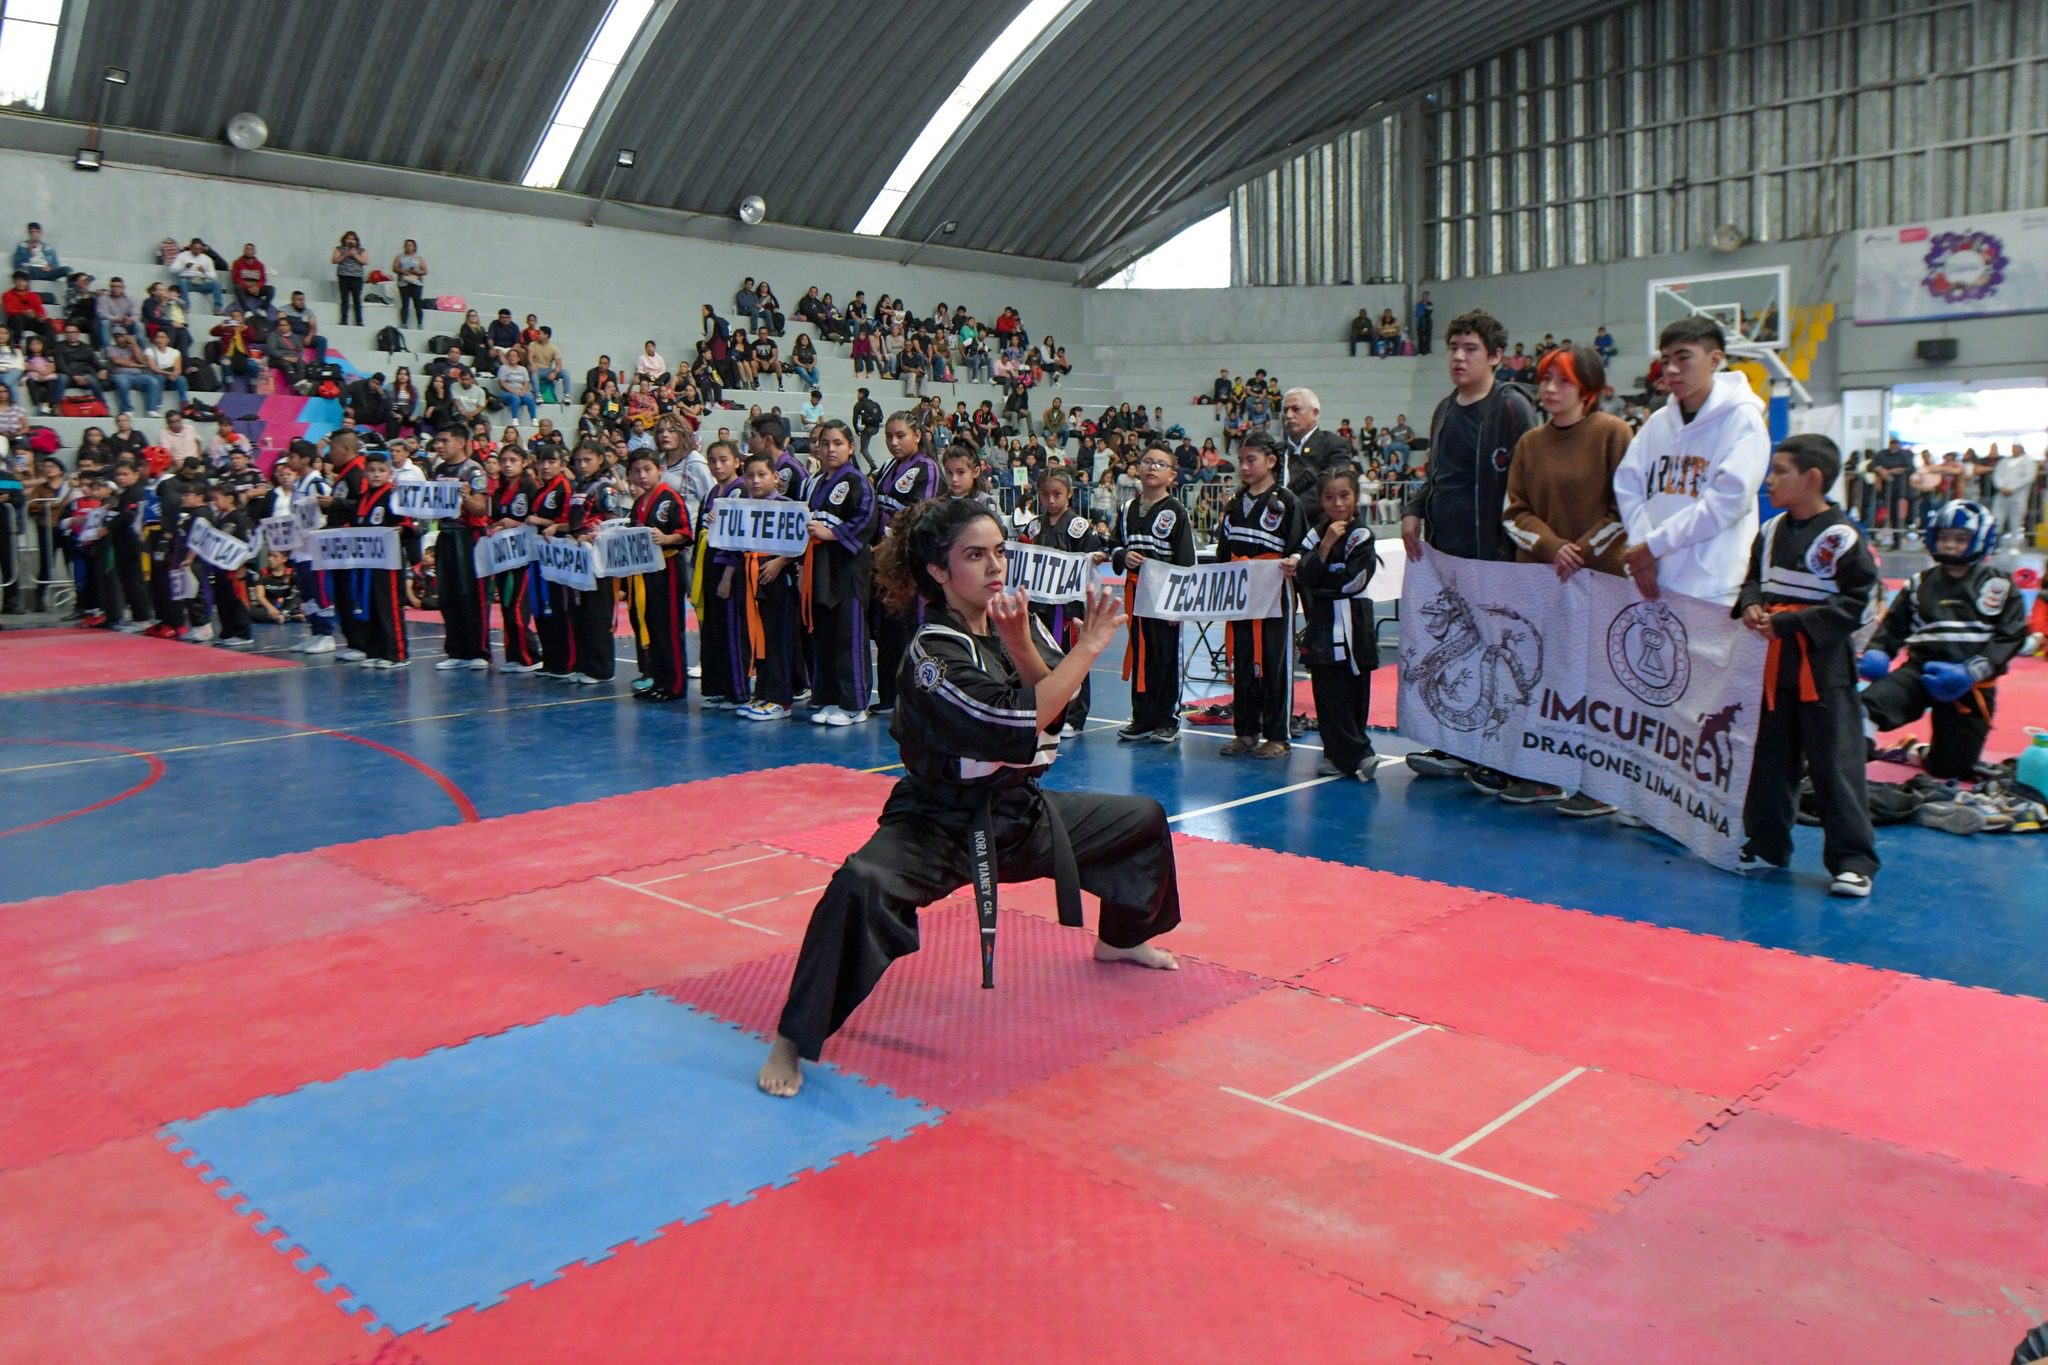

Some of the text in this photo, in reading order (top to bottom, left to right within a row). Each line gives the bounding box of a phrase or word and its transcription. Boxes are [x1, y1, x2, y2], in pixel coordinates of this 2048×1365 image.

[1164, 567, 1248, 612] TECAMAC
[1523, 731, 1642, 784] DRAGONES
[1646, 770, 1682, 808] LIMA
[1687, 794, 1730, 837] LAMA
[973, 830, 987, 857] NORA
[977, 860, 992, 896] VIANEY
